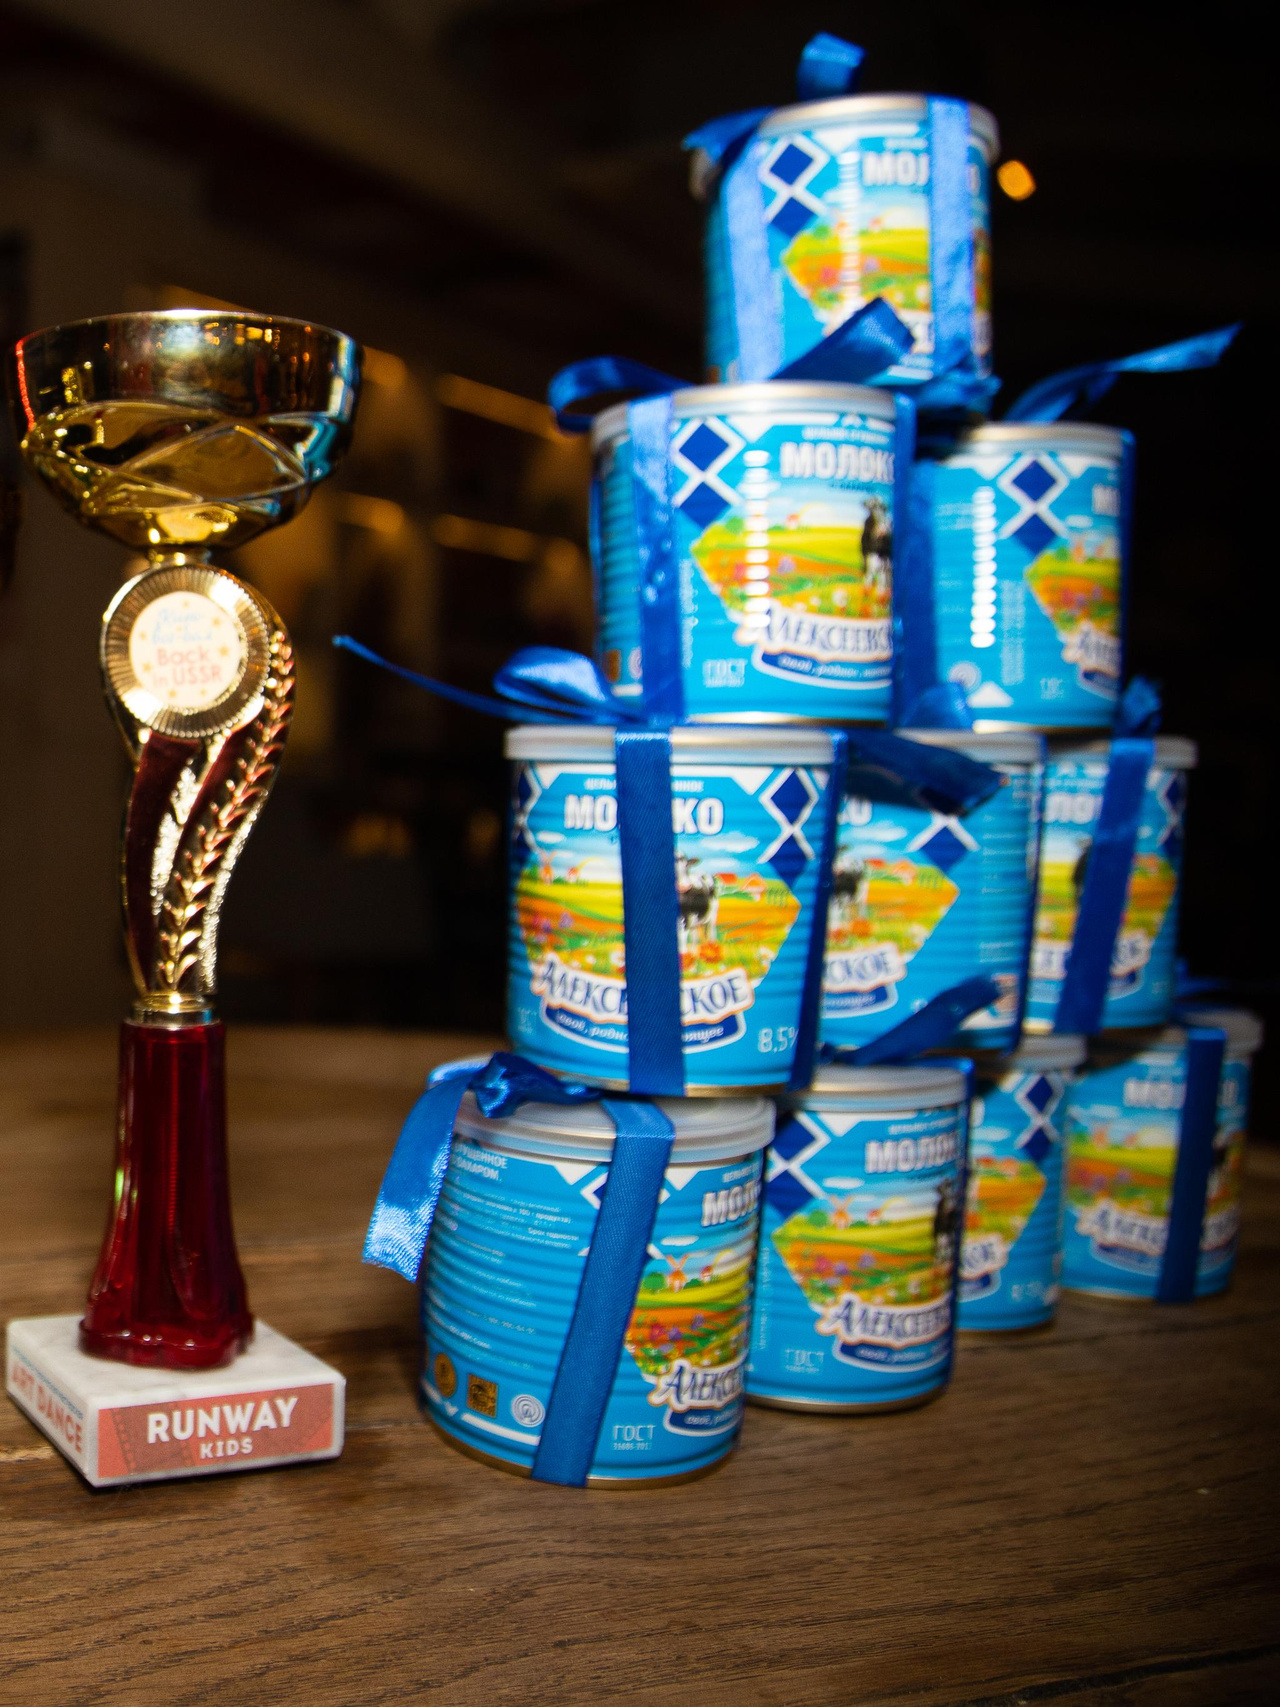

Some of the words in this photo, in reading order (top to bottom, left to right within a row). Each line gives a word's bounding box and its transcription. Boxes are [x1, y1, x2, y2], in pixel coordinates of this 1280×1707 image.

[780, 441, 894, 484] МОЛОК
[157, 645, 211, 666] Back
[172, 664, 222, 686] USSR
[564, 793, 724, 836] МОКО
[147, 1397, 298, 1444] RUNWAY
[200, 1438, 253, 1459] KIDS
